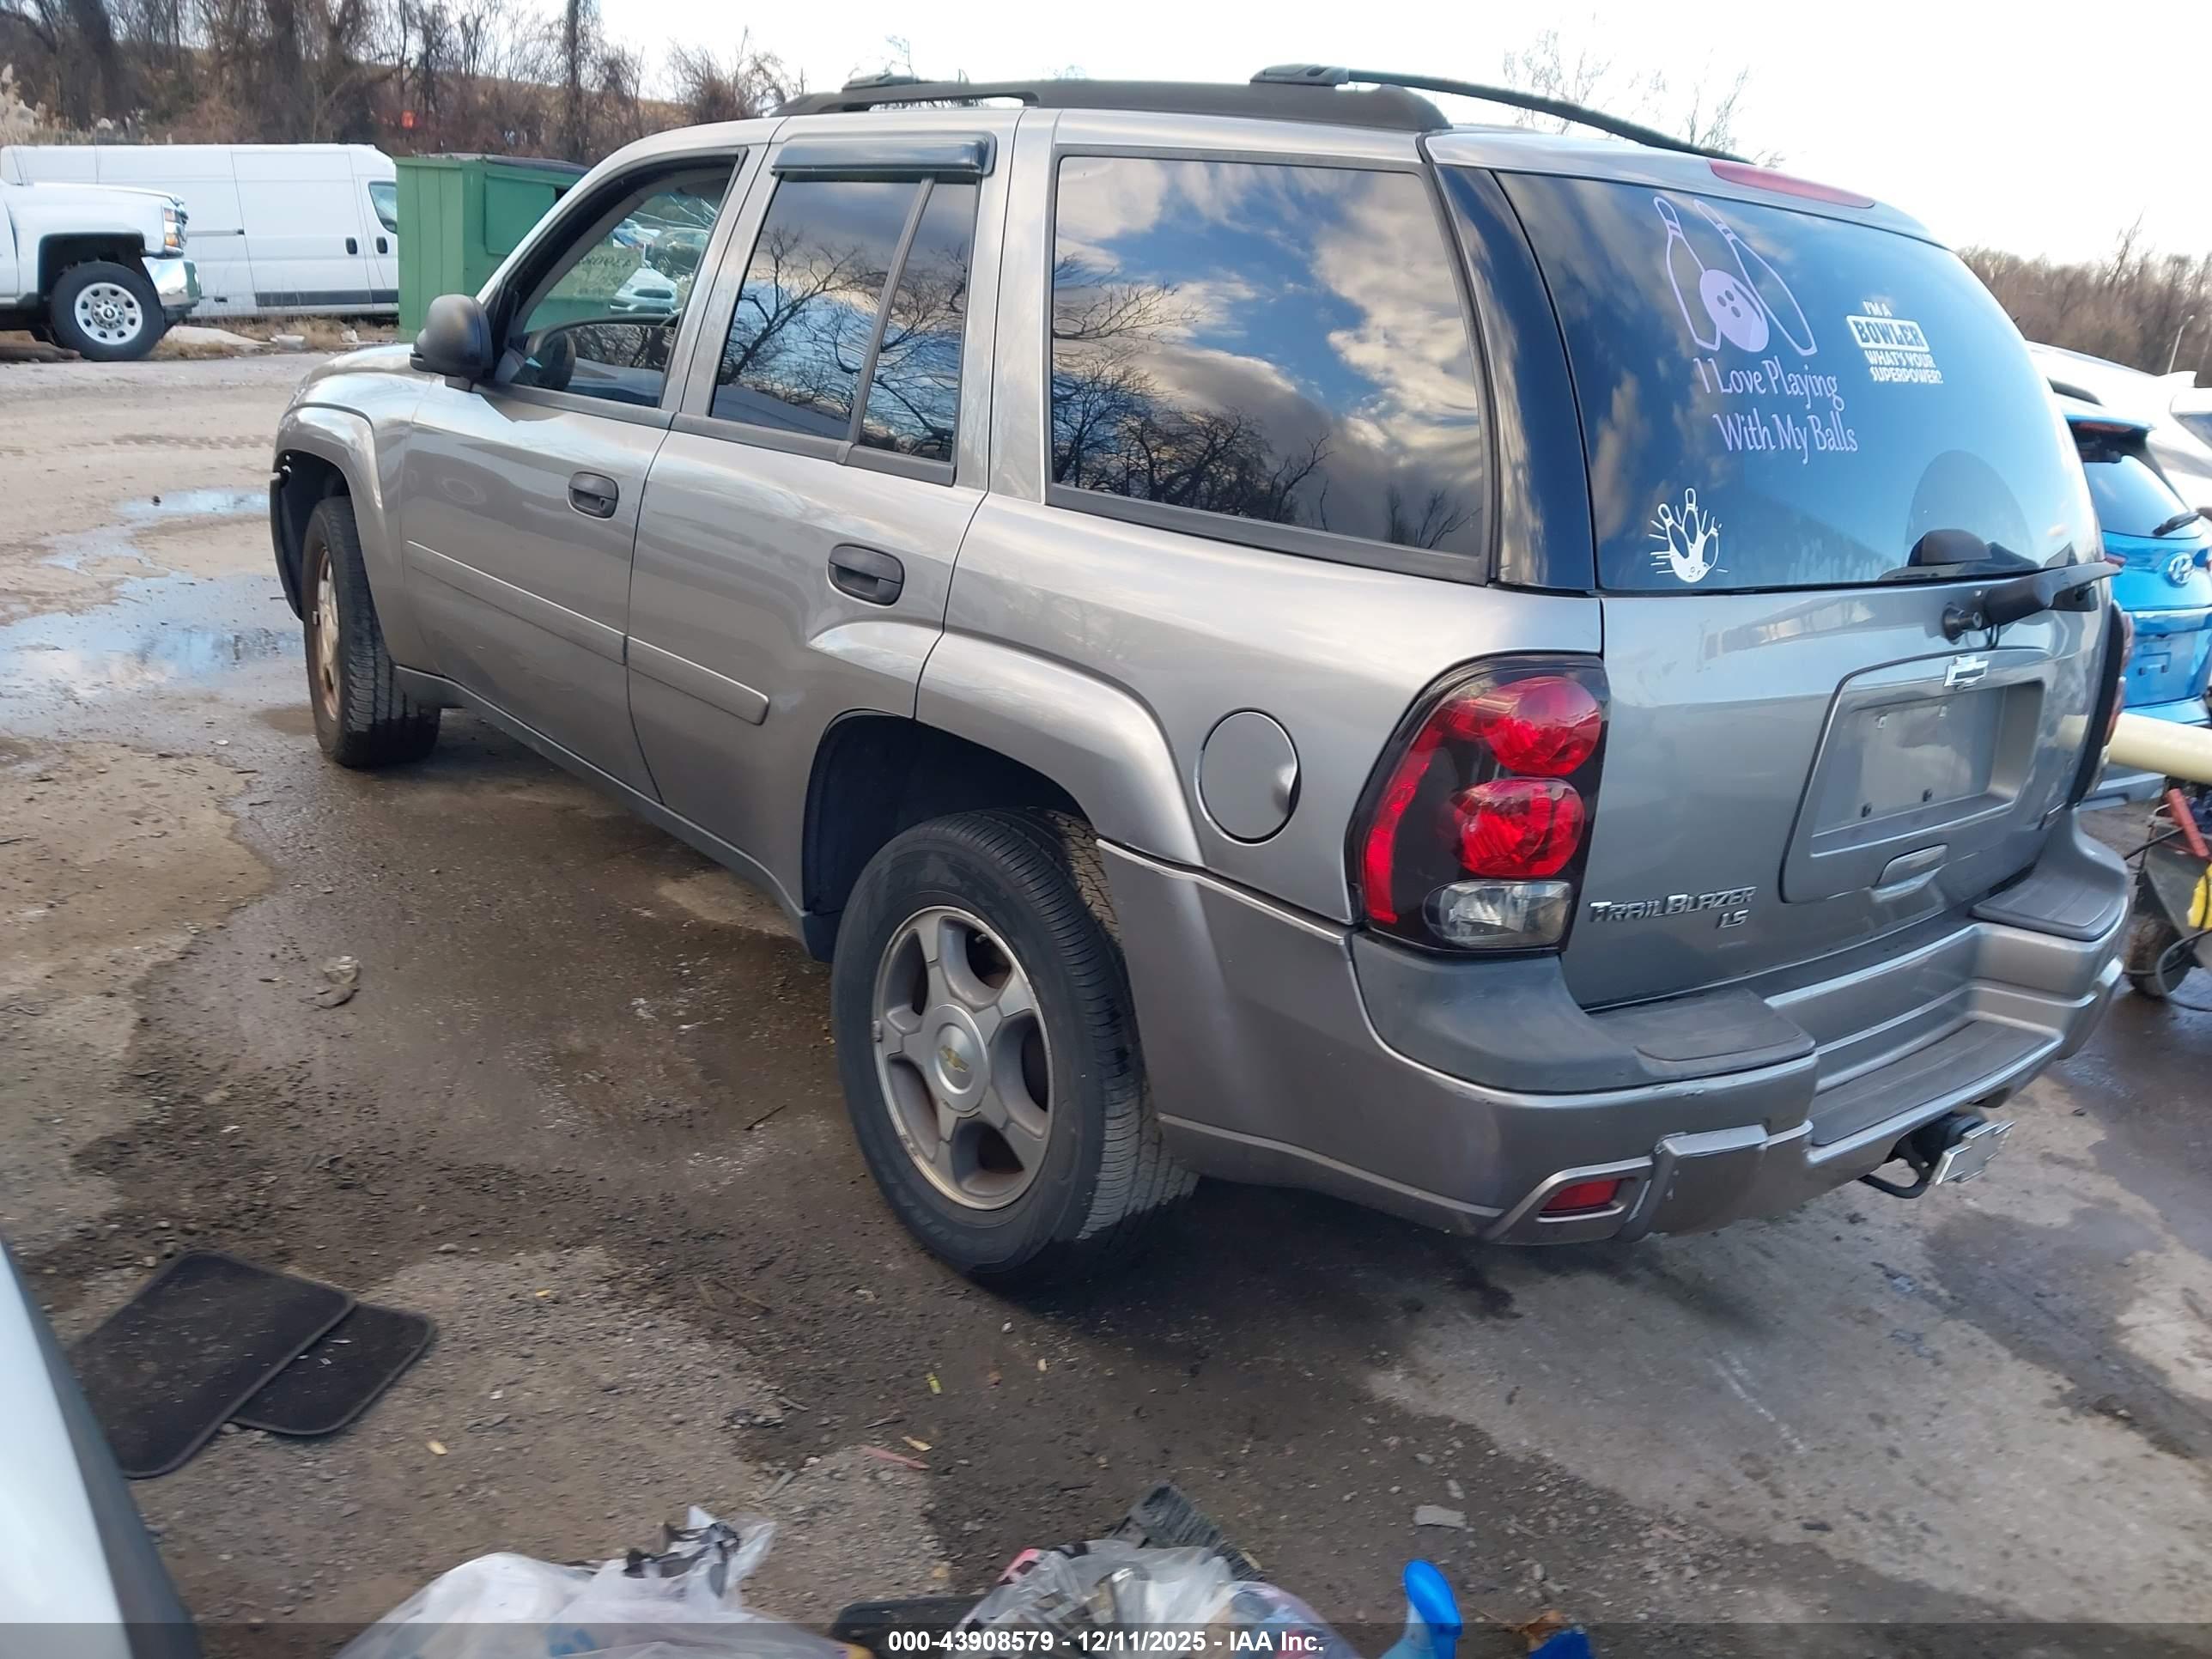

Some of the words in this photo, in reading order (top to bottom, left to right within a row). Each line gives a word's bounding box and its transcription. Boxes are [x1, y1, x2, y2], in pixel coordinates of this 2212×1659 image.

[1881, 302, 1893, 317] A
[1852, 319, 1925, 348] BOWLER
[1905, 352, 1936, 368] YOUR
[1707, 357, 1767, 395] Love
[1762, 355, 1845, 411] Playing
[1869, 366, 1944, 384] SUPERPOWER?
[1712, 407, 1776, 452] With
[1771, 413, 1809, 465] My
[1807, 410, 1859, 452] Balls
[1717, 908, 1750, 929] LS
